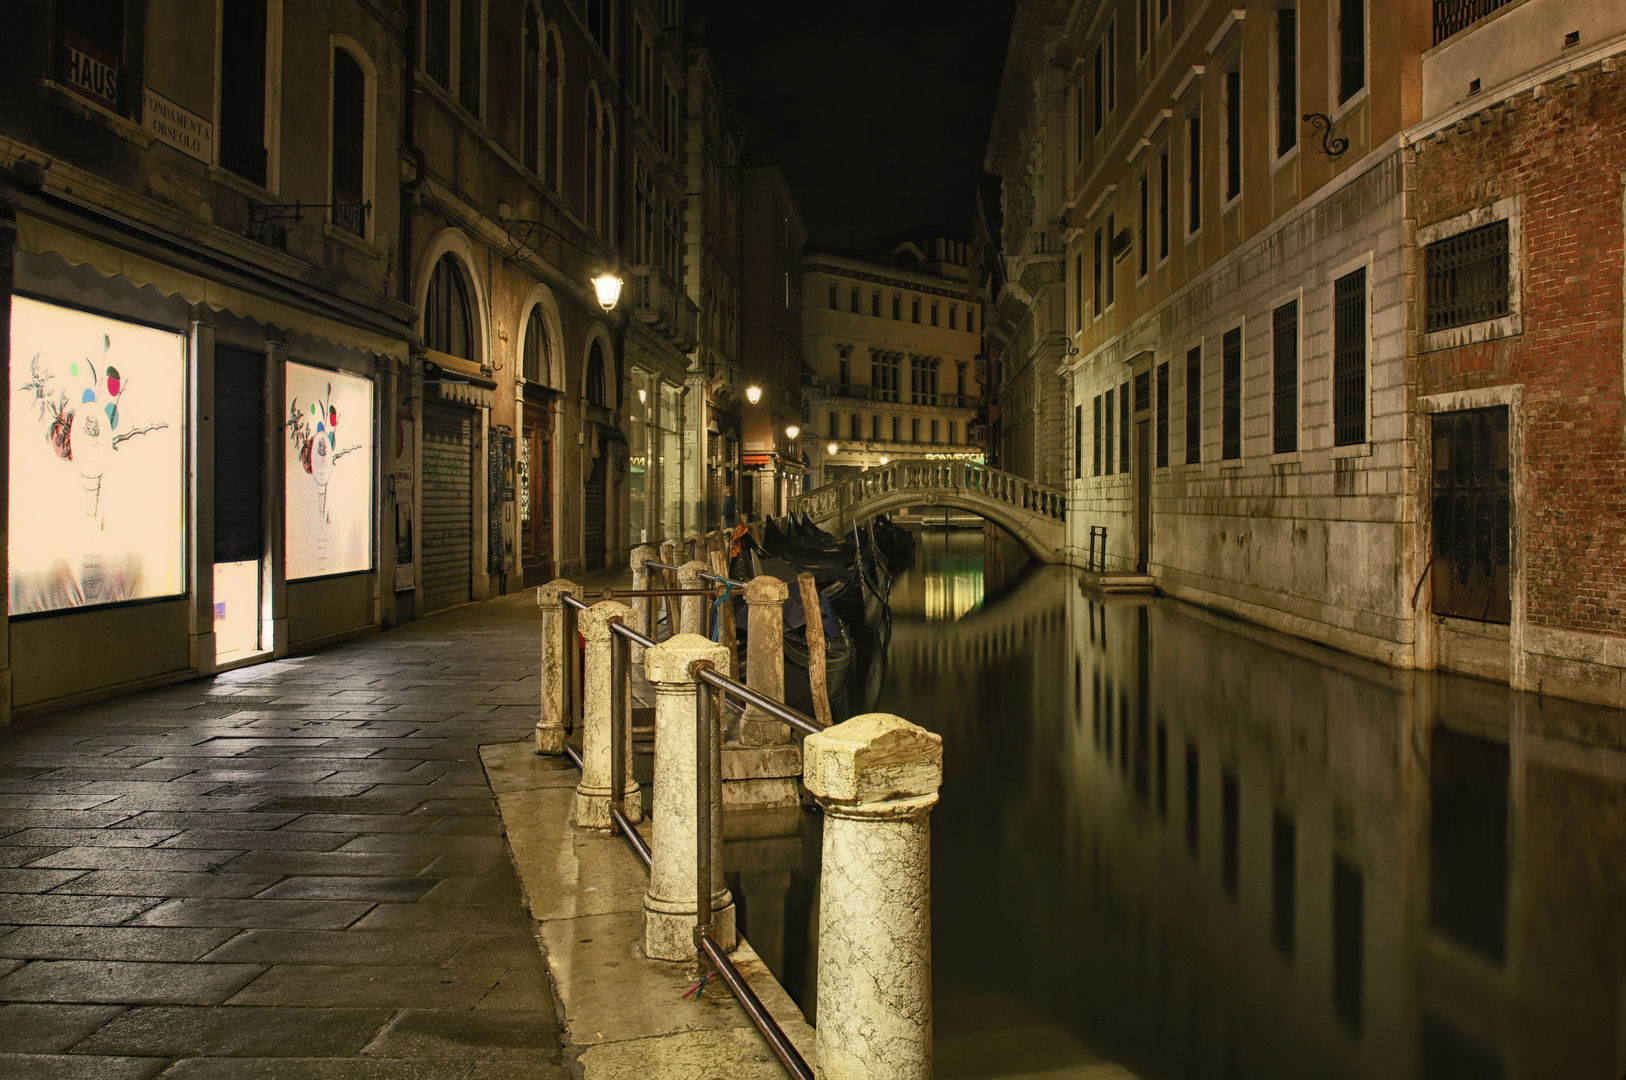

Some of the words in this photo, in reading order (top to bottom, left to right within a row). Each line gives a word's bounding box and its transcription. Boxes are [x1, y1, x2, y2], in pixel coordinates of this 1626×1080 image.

[67, 49, 116, 101] HAUS
[143, 94, 210, 141] FONDAMENTA
[153, 118, 200, 153] ORSEOLO
[335, 200, 360, 230] HAUS
